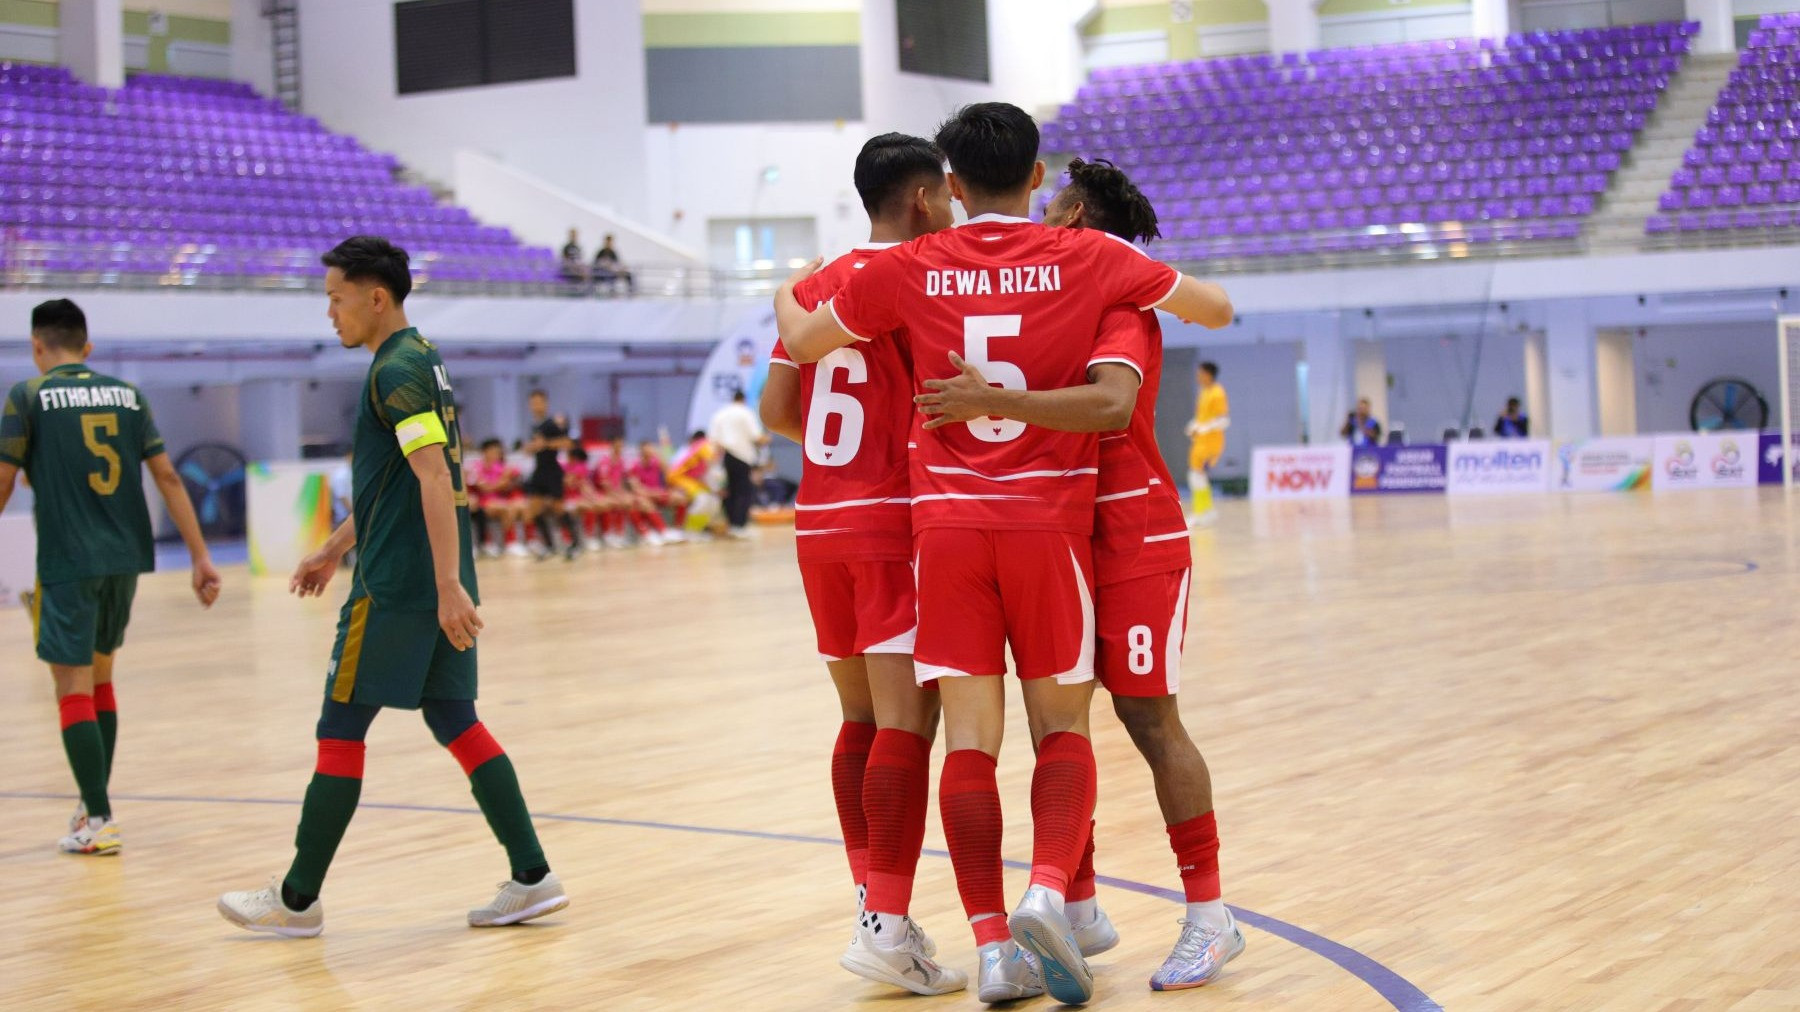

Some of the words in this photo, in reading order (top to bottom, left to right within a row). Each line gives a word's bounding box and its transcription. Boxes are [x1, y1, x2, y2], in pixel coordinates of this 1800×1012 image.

[926, 269, 992, 296] DEWA
[999, 265, 1061, 294] RIZKI
[963, 314, 1028, 443] 5
[805, 347, 868, 467] 6
[80, 412, 121, 496] 5
[1455, 450, 1541, 469] molten
[1266, 469, 1333, 490] NOW
[1128, 625, 1153, 675] 8
